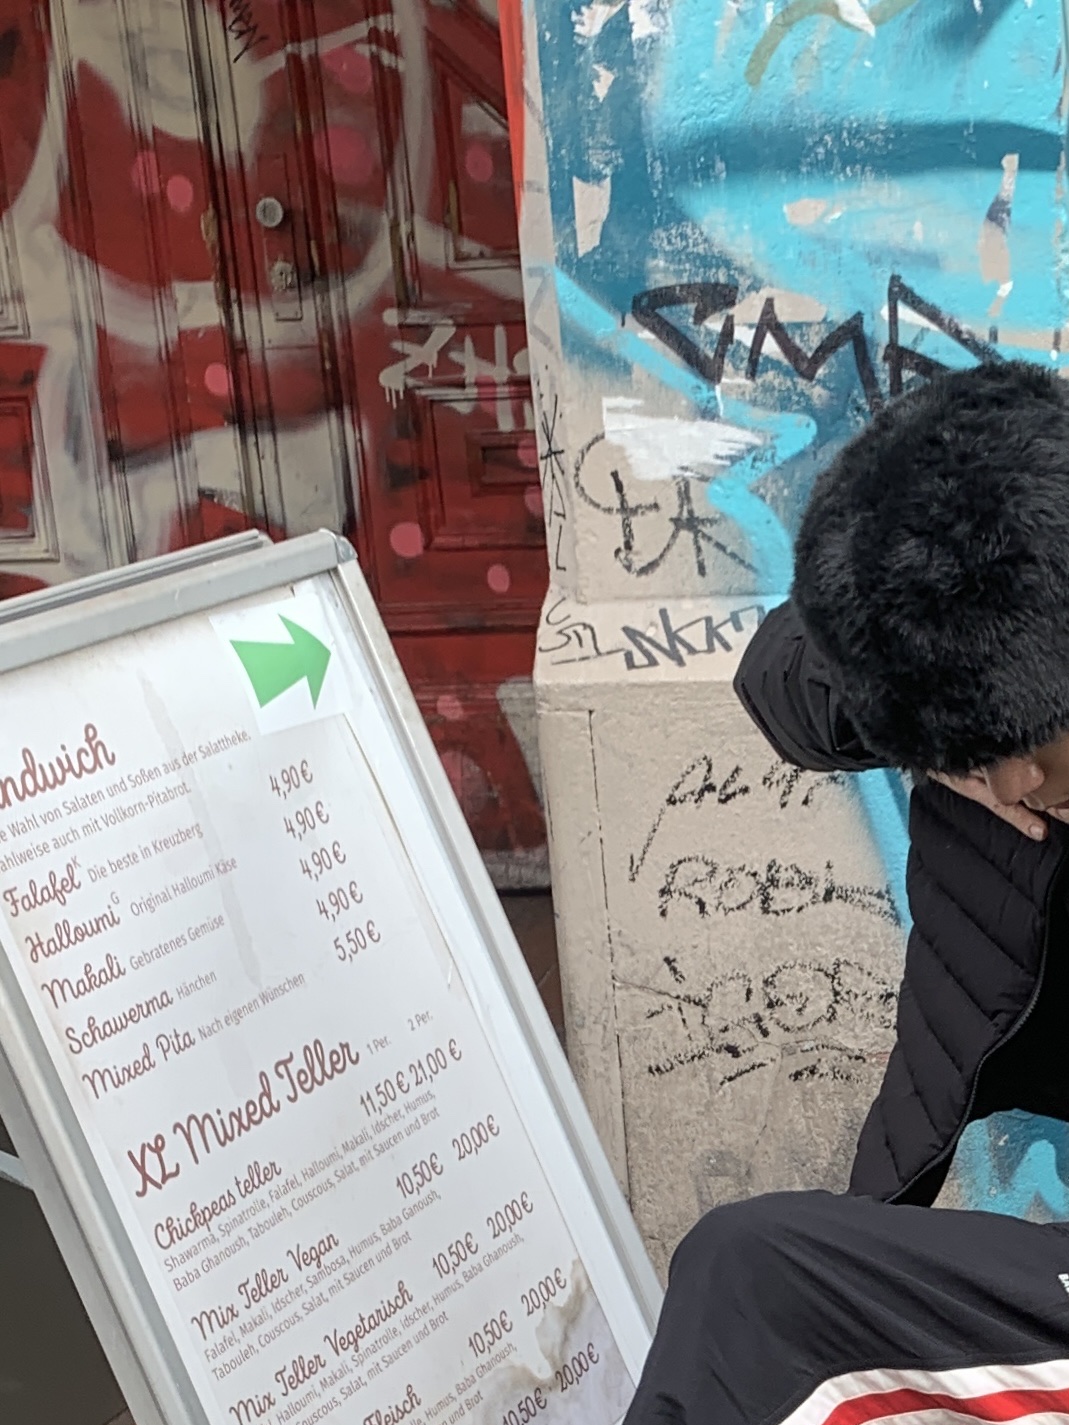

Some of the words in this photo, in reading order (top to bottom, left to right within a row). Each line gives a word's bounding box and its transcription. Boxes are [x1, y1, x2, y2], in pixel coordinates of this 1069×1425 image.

[6, 813, 41, 838] Wahl
[38, 807, 63, 825] von
[61, 789, 106, 816] Salaten
[105, 776, 129, 798] und
[126, 766, 162, 789] Soßen
[161, 757, 182, 775] aus
[181, 750, 198, 767] der
[197, 730, 252, 760] Salattheke.
[51, 826, 81, 850] auch
[81, 817, 103, 837] mit
[3, 862, 82, 918] Falafel
[86, 865, 108, 883] Die
[106, 851, 140, 875] beste
[138, 846, 152, 860] in
[151, 822, 204, 854] Kreuzberg
[24, 896, 121, 964] Halloumi
[129, 886, 173, 917] Original
[170, 864, 216, 898] Halloumi
[214, 857, 238, 876] Käse
[40, 952, 127, 1010] Makali
[129, 934, 188, 971] Gebratenes
[187, 914, 225, 942] Gemüse
[64, 990, 174, 1055] Schawerma
[175, 971, 218, 1000] Hänchen
[81, 1042, 156, 1100] Mixed
[155, 1028, 196, 1062] Pita
[197, 1017, 224, 1041] Nach
[223, 998, 261, 1027] eigenen
[258, 973, 306, 1006] Wünschen
[127, 1133, 181, 1198] XL
[172, 1070, 281, 1166] Mixed
[273, 1038, 360, 1104] Teller
[372, 1035, 392, 1052] Per.
[414, 1010, 433, 1028] Per.
[154, 1188, 237, 1251] Chickpeas
[234, 1160, 282, 1199] teller
[163, 1228, 220, 1273] Shawarma,
[268, 1173, 303, 1203] Falafel,
[300, 1146, 344, 1182] Halloumi,
[341, 1127, 373, 1154] Makali,
[403, 1089, 436, 1114] Humus,
[172, 1267, 202, 1292] Baba
[200, 1235, 250, 1274] Ghanoush,
[247, 1205, 293, 1240] Tabouleh,
[290, 1177, 337, 1212] Couscous,
[333, 1160, 360, 1184] Salat,
[358, 1149, 375, 1167] mit
[372, 1130, 405, 1157] Saucen
[404, 1116, 422, 1137] und
[419, 1106, 441, 1126] Brot
[190, 1303, 240, 1341] Mix
[237, 1268, 289, 1310] Teller
[286, 1233, 340, 1272] Vegan
[203, 1330, 241, 1364] Falafel,
[238, 1308, 273, 1338] Makali,
[305, 1254, 351, 1289] Sambosa,
[347, 1231, 382, 1259] Humus,
[379, 1215, 403, 1236] Baba
[401, 1189, 442, 1221] Ganoush,
[210, 1343, 260, 1382] Tabouleh,
[257, 1311, 304, 1348] Couscous,
[301, 1291, 330, 1316] Salat,
[327, 1278, 345, 1297] mit
[342, 1257, 376, 1286] Saucen
[375, 1241, 393, 1264] und
[391, 1230, 413, 1251] Brot
[275, 1384, 322, 1425] Halloumi,
[318, 1360, 354, 1392] Makali,
[431, 1279, 465, 1306] Humus,
[461, 1262, 484, 1284] Baba
[482, 1230, 525, 1268] Ghanoush,
[274, 1353, 327, 1397] Teller
[323, 1279, 414, 1357] Vegetarisch
[339, 1375, 368, 1401] Salat,
[366, 1361, 384, 1381] mit
[380, 1339, 414, 1369] Saucen
[412, 1323, 431, 1345] und
[428, 1310, 449, 1332] Brot
[424, 1392, 458, 1422] Humus,
[454, 1374, 477, 1396] Baba
[475, 1342, 518, 1379] Ghanoush,
[448, 1403, 466, 1425] und
[464, 1389, 484, 1411] Brot
